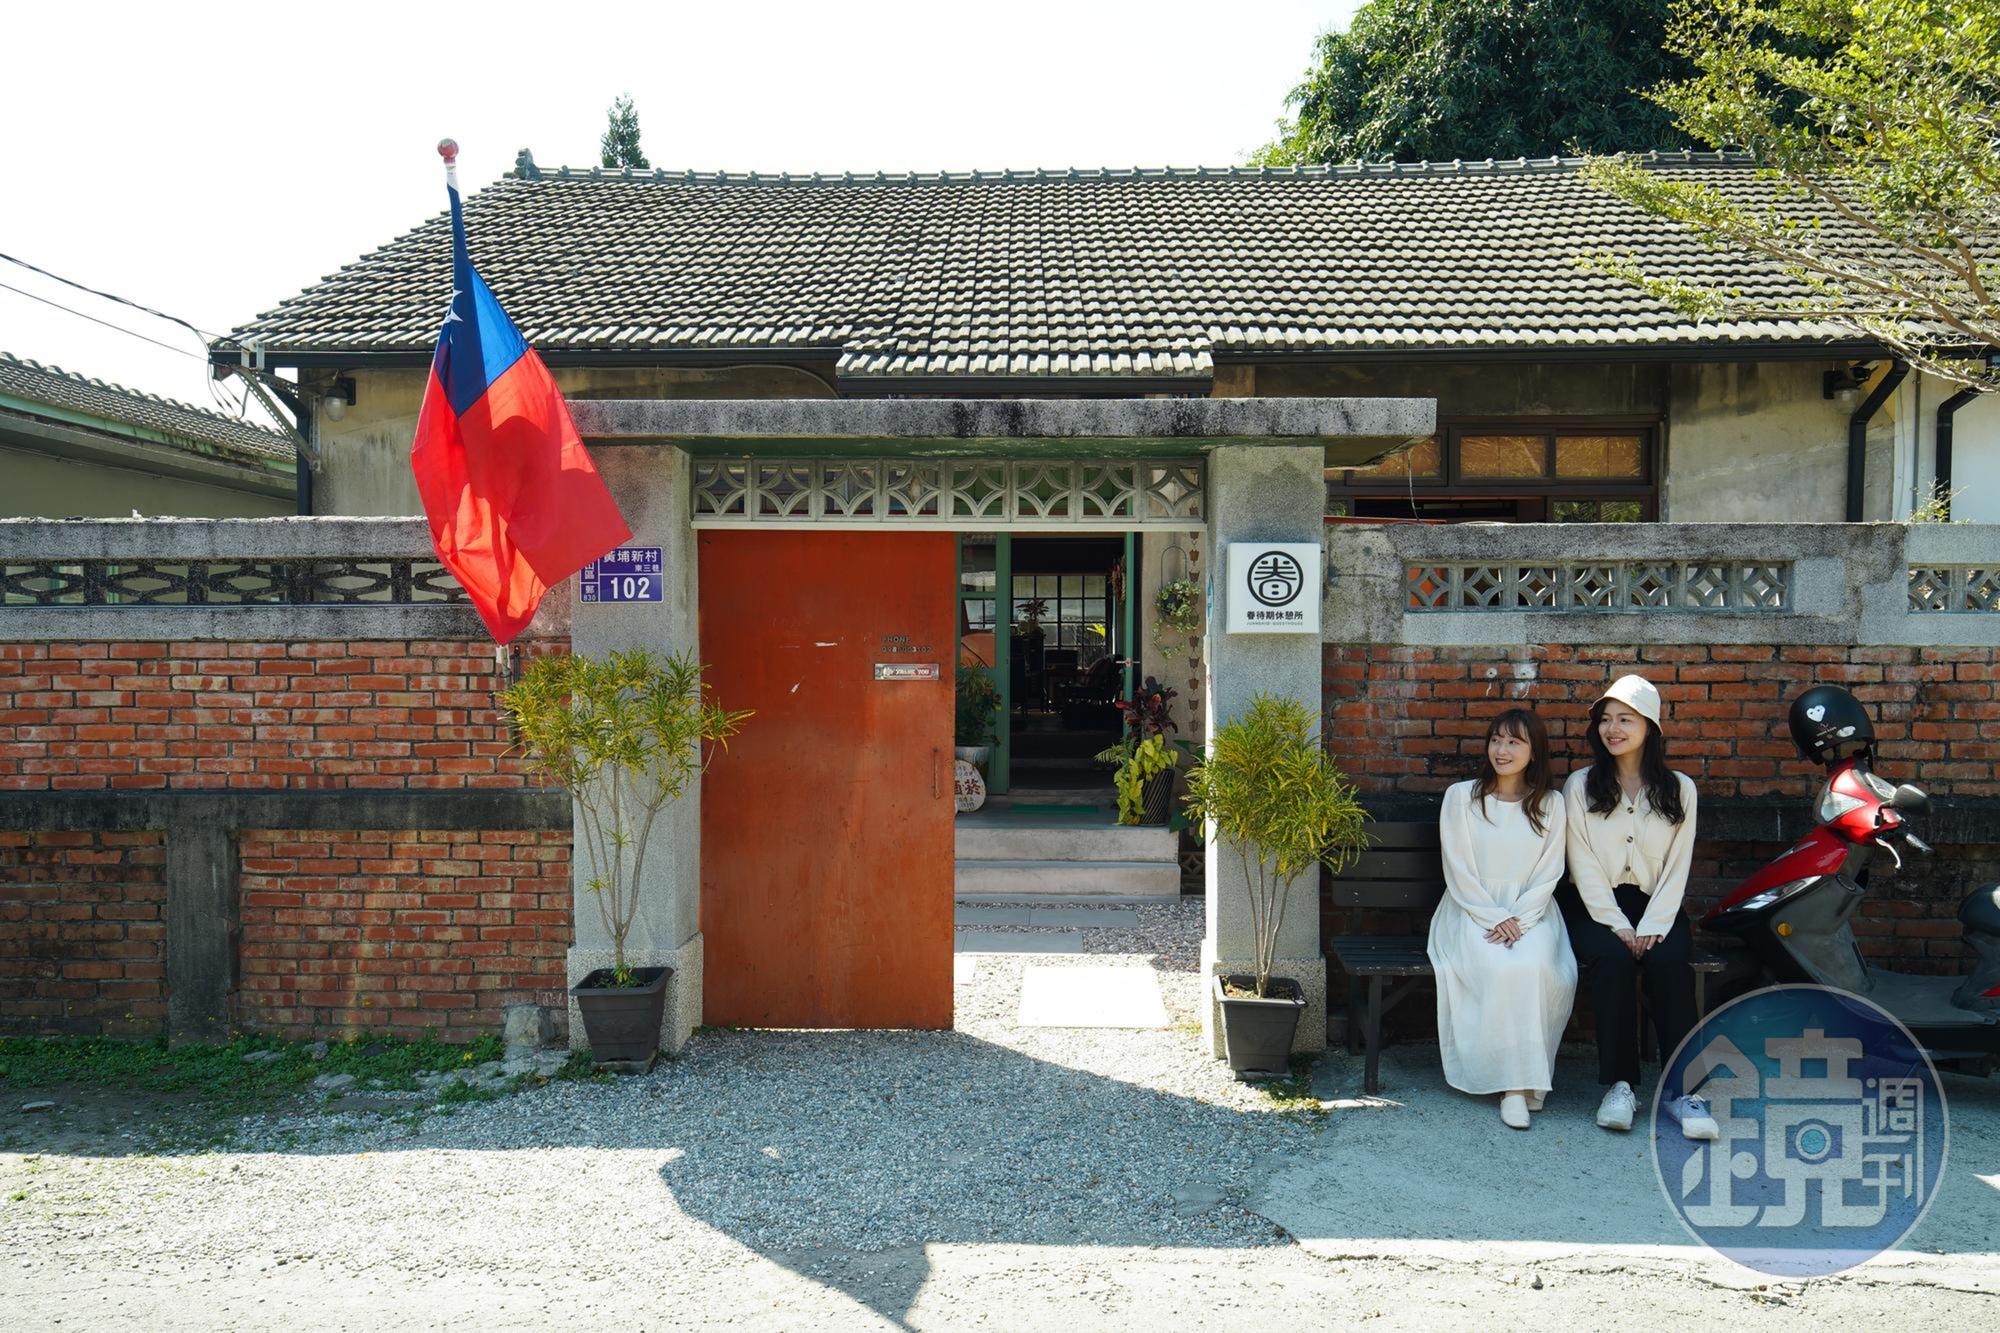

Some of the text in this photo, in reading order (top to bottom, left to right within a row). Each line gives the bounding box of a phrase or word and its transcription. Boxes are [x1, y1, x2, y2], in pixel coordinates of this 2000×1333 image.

[635, 564, 660, 572] 東三巷
[610, 577, 650, 599] 102
[1247, 611, 1303, 620] 春待期休憩所
